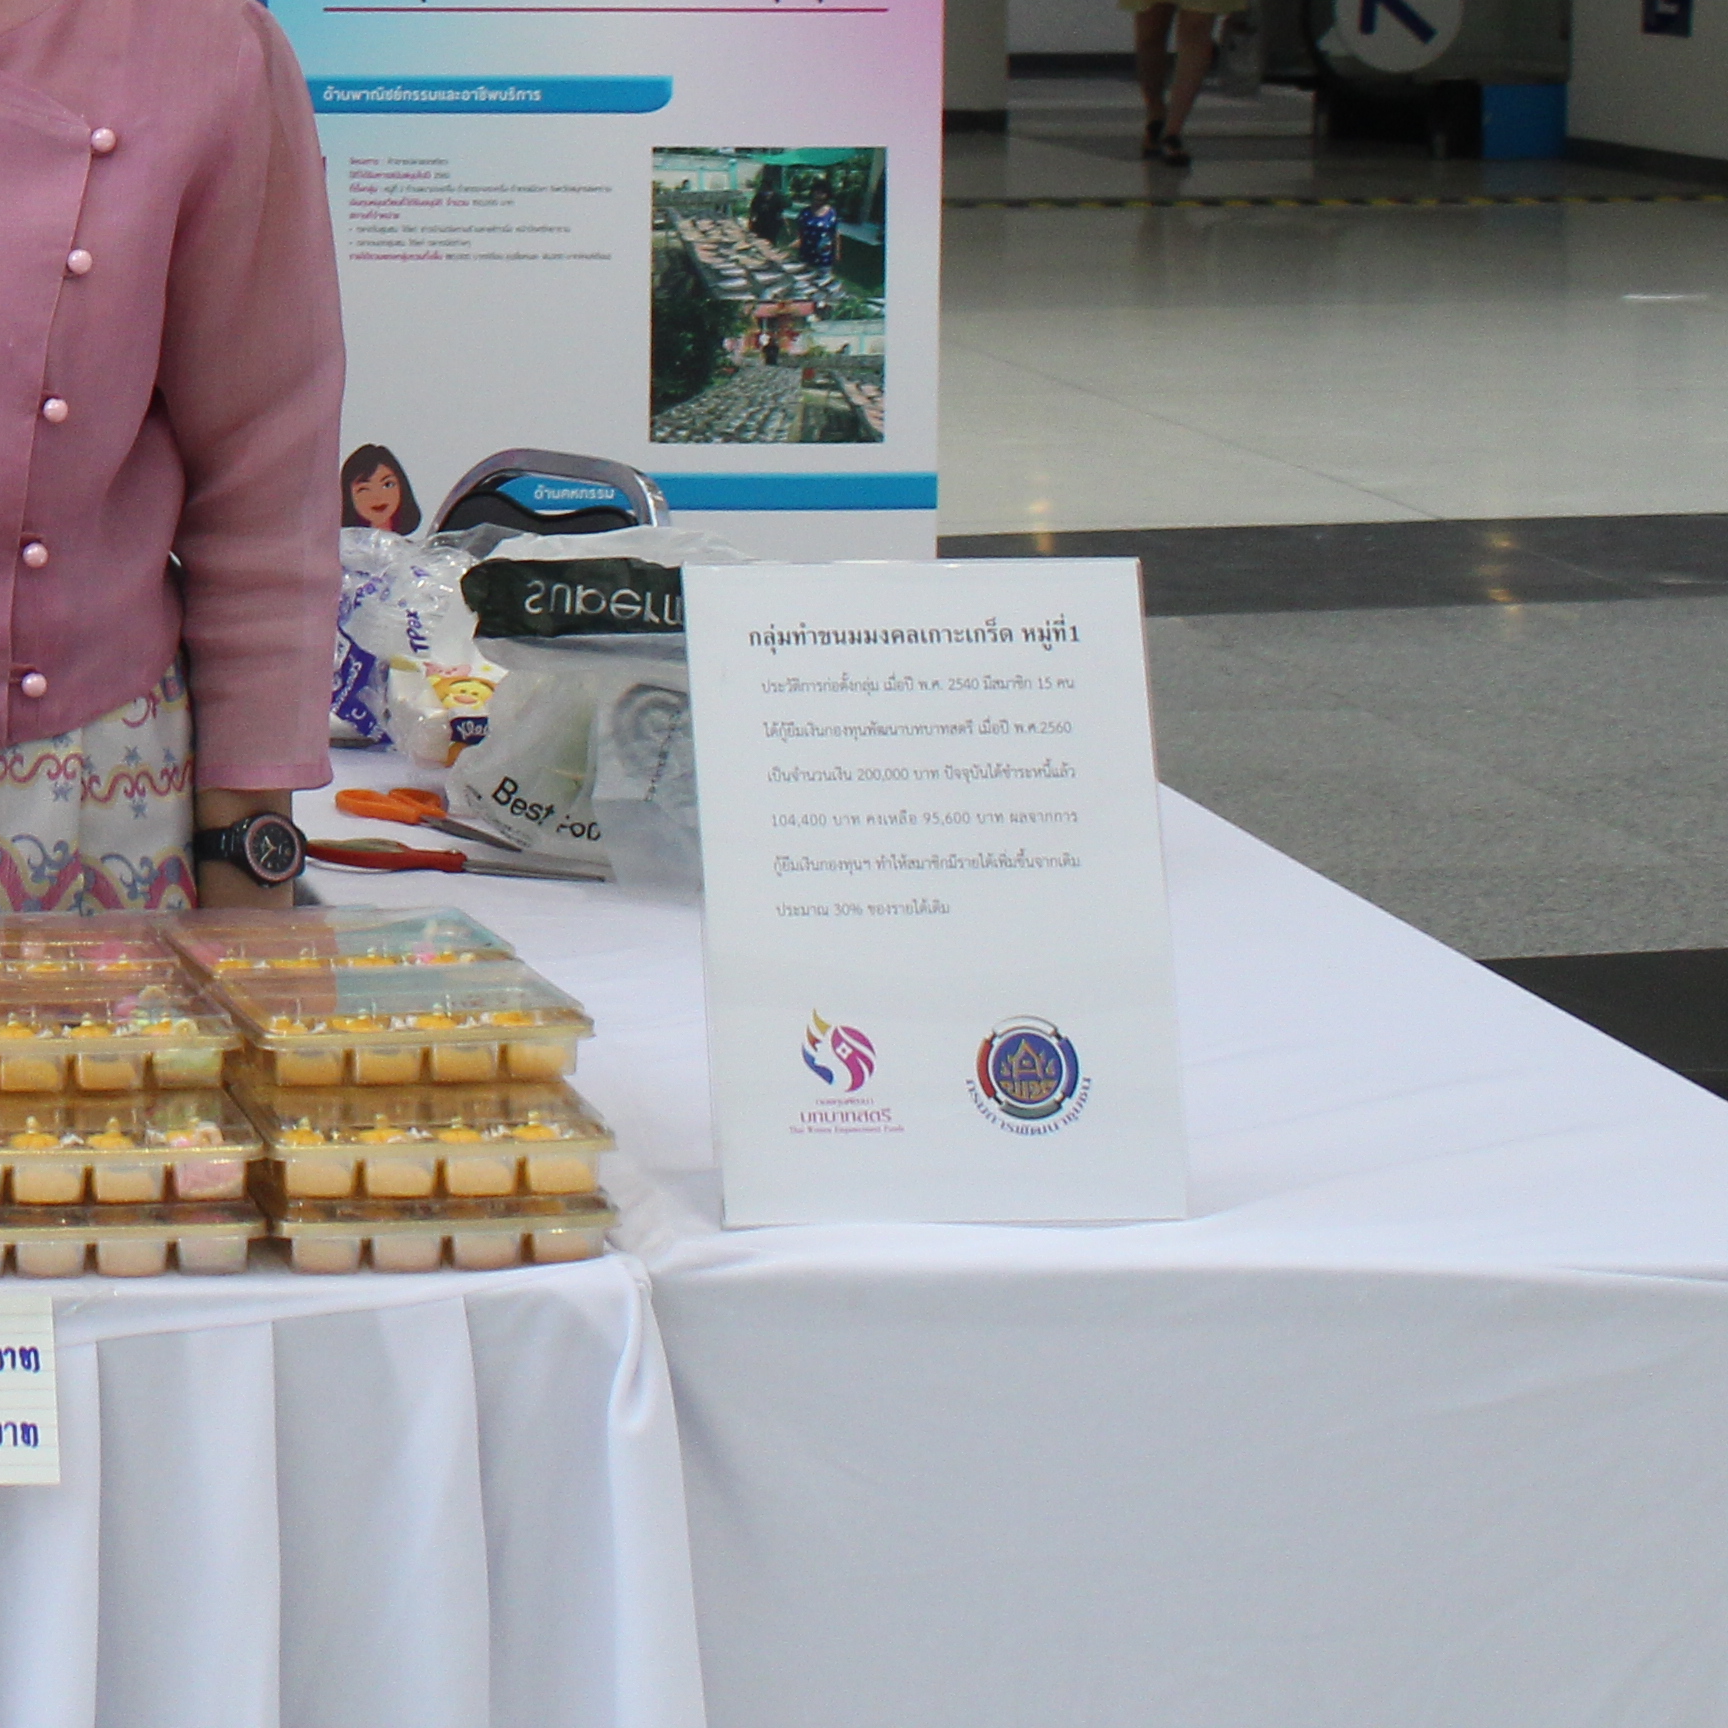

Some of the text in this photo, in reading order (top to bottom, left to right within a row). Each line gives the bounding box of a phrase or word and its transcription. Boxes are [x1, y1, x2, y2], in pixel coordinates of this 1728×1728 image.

[749, 617, 1014, 655] กลุ่มทำขนมมงคลเกาะเกร็ด
[948, 677, 979, 691] 2540
[1038, 676, 1052, 690] 15
[857, 768, 909, 782] 200,000
[491, 775, 557, 826] Best
[800, 1108, 892, 1123] บทบาทสตรี
